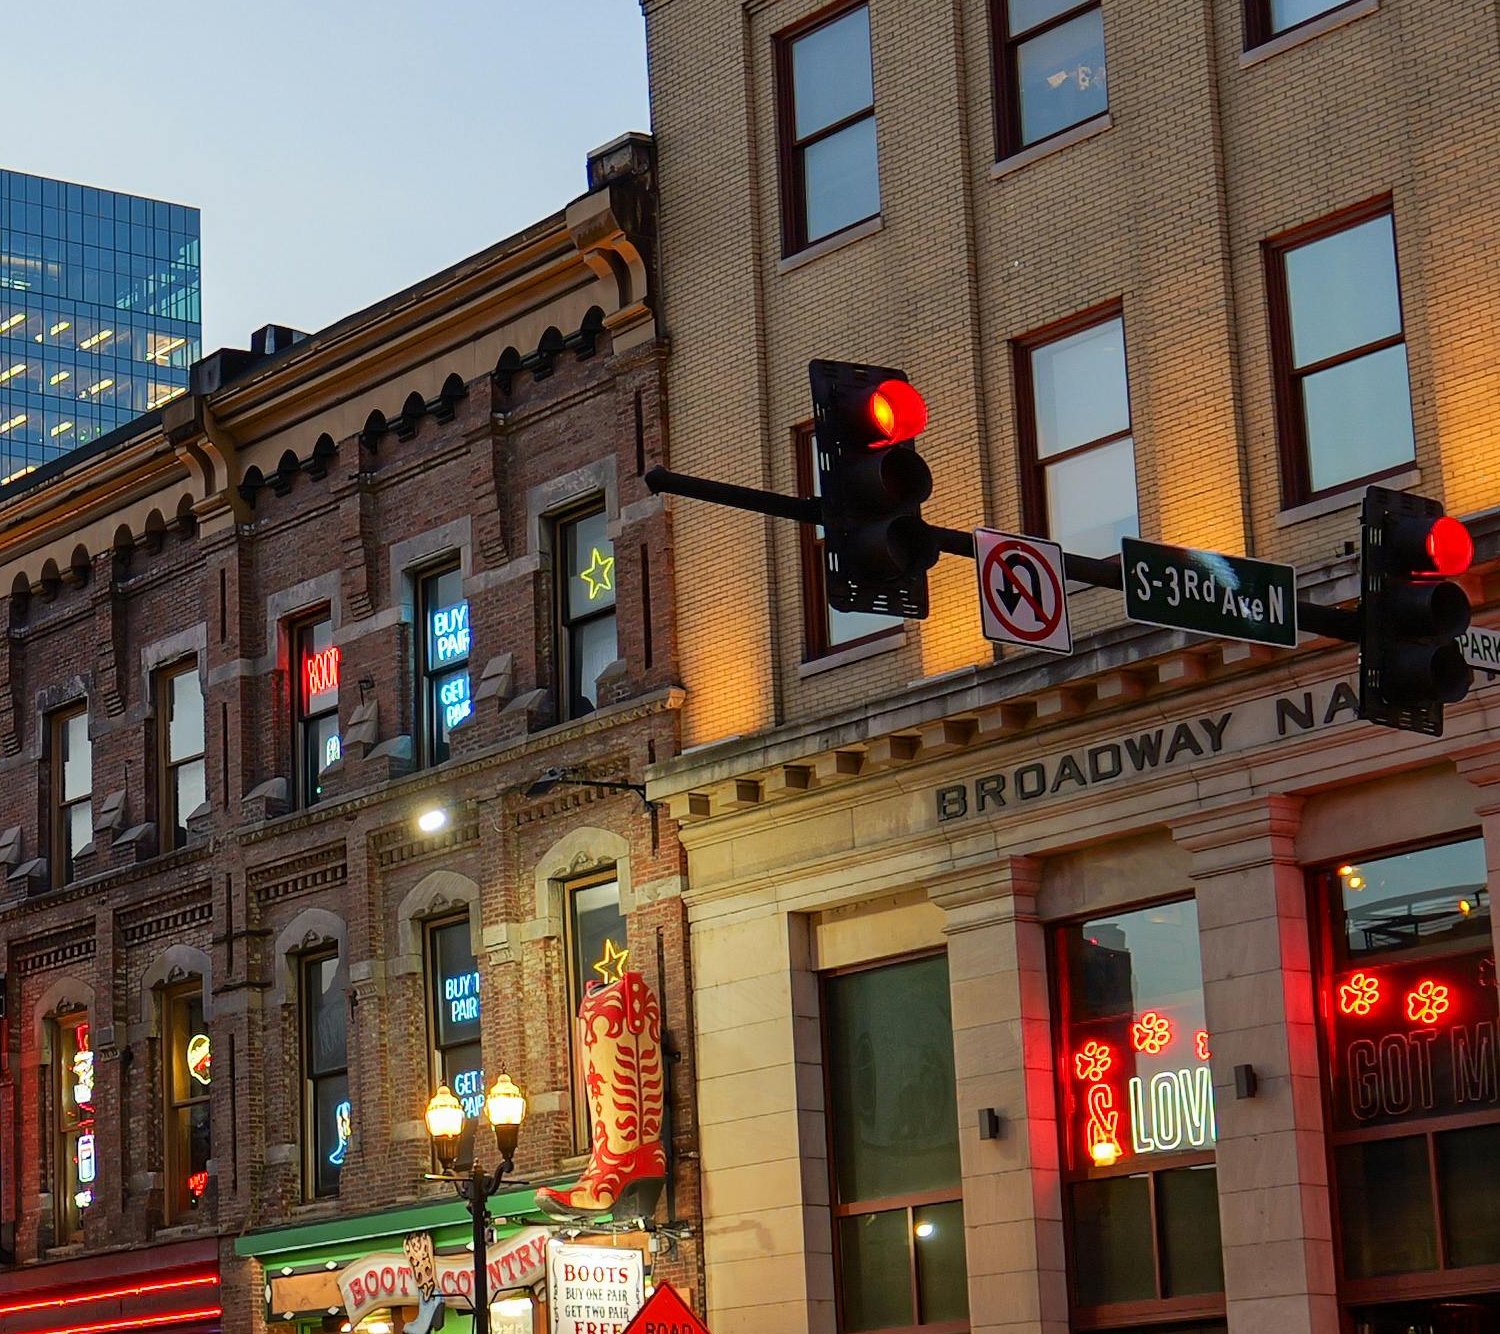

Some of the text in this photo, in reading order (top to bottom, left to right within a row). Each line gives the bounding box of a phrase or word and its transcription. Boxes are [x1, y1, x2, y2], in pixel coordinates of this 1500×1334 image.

[1222, 589, 1264, 623] Ave
[1267, 590, 1285, 626] N
[434, 605, 469, 637] BUY
[441, 679, 465, 705] GET
[935, 712, 1233, 823] BROADWAY
[446, 976, 470, 1001] BUY
[452, 997, 479, 1023] PAIR
[455, 1070, 478, 1096] GET
[1128, 1065, 1216, 1155] LOV
[348, 1235, 549, 1307] BOOT CONTRY
[563, 1263, 629, 1284] BOOTS
[565, 1287, 630, 1305] BUY ONE PAIR
[565, 1306, 631, 1321] GET TWO PAIR
